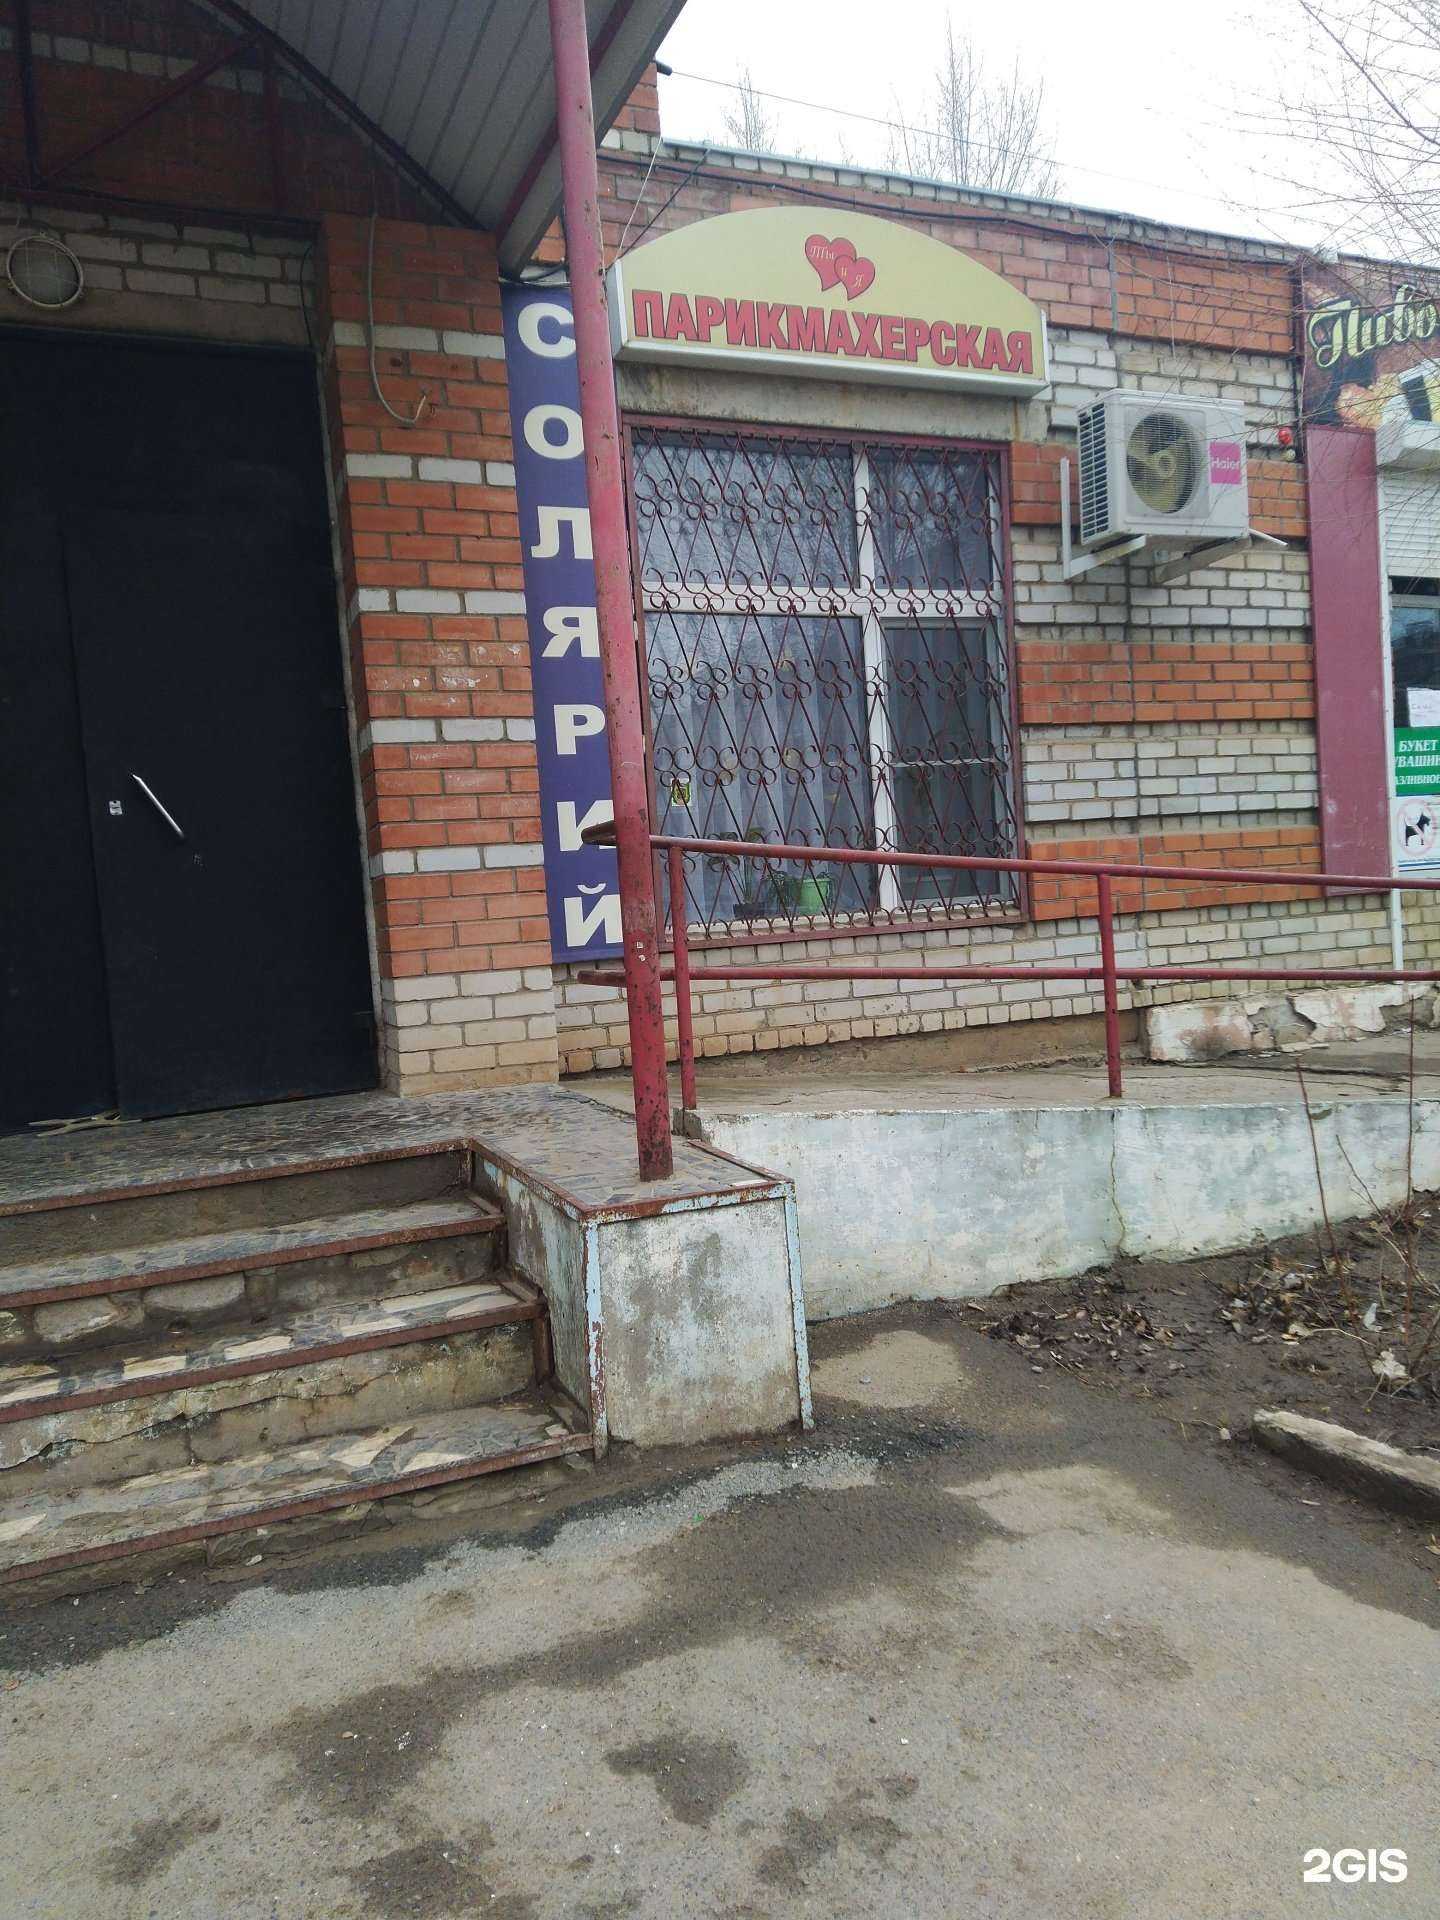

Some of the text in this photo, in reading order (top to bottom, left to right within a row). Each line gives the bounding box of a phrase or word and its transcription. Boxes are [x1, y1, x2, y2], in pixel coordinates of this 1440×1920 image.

[631, 289, 1034, 374] ПАРИКМАХЕРСКАЯ
[1308, 284, 1437, 368] Пиво
[1212, 456, 1240, 470] Haier
[518, 302, 624, 947] СОЛЯРИЙ
[1399, 740, 1438, 752] БУКЕТ
